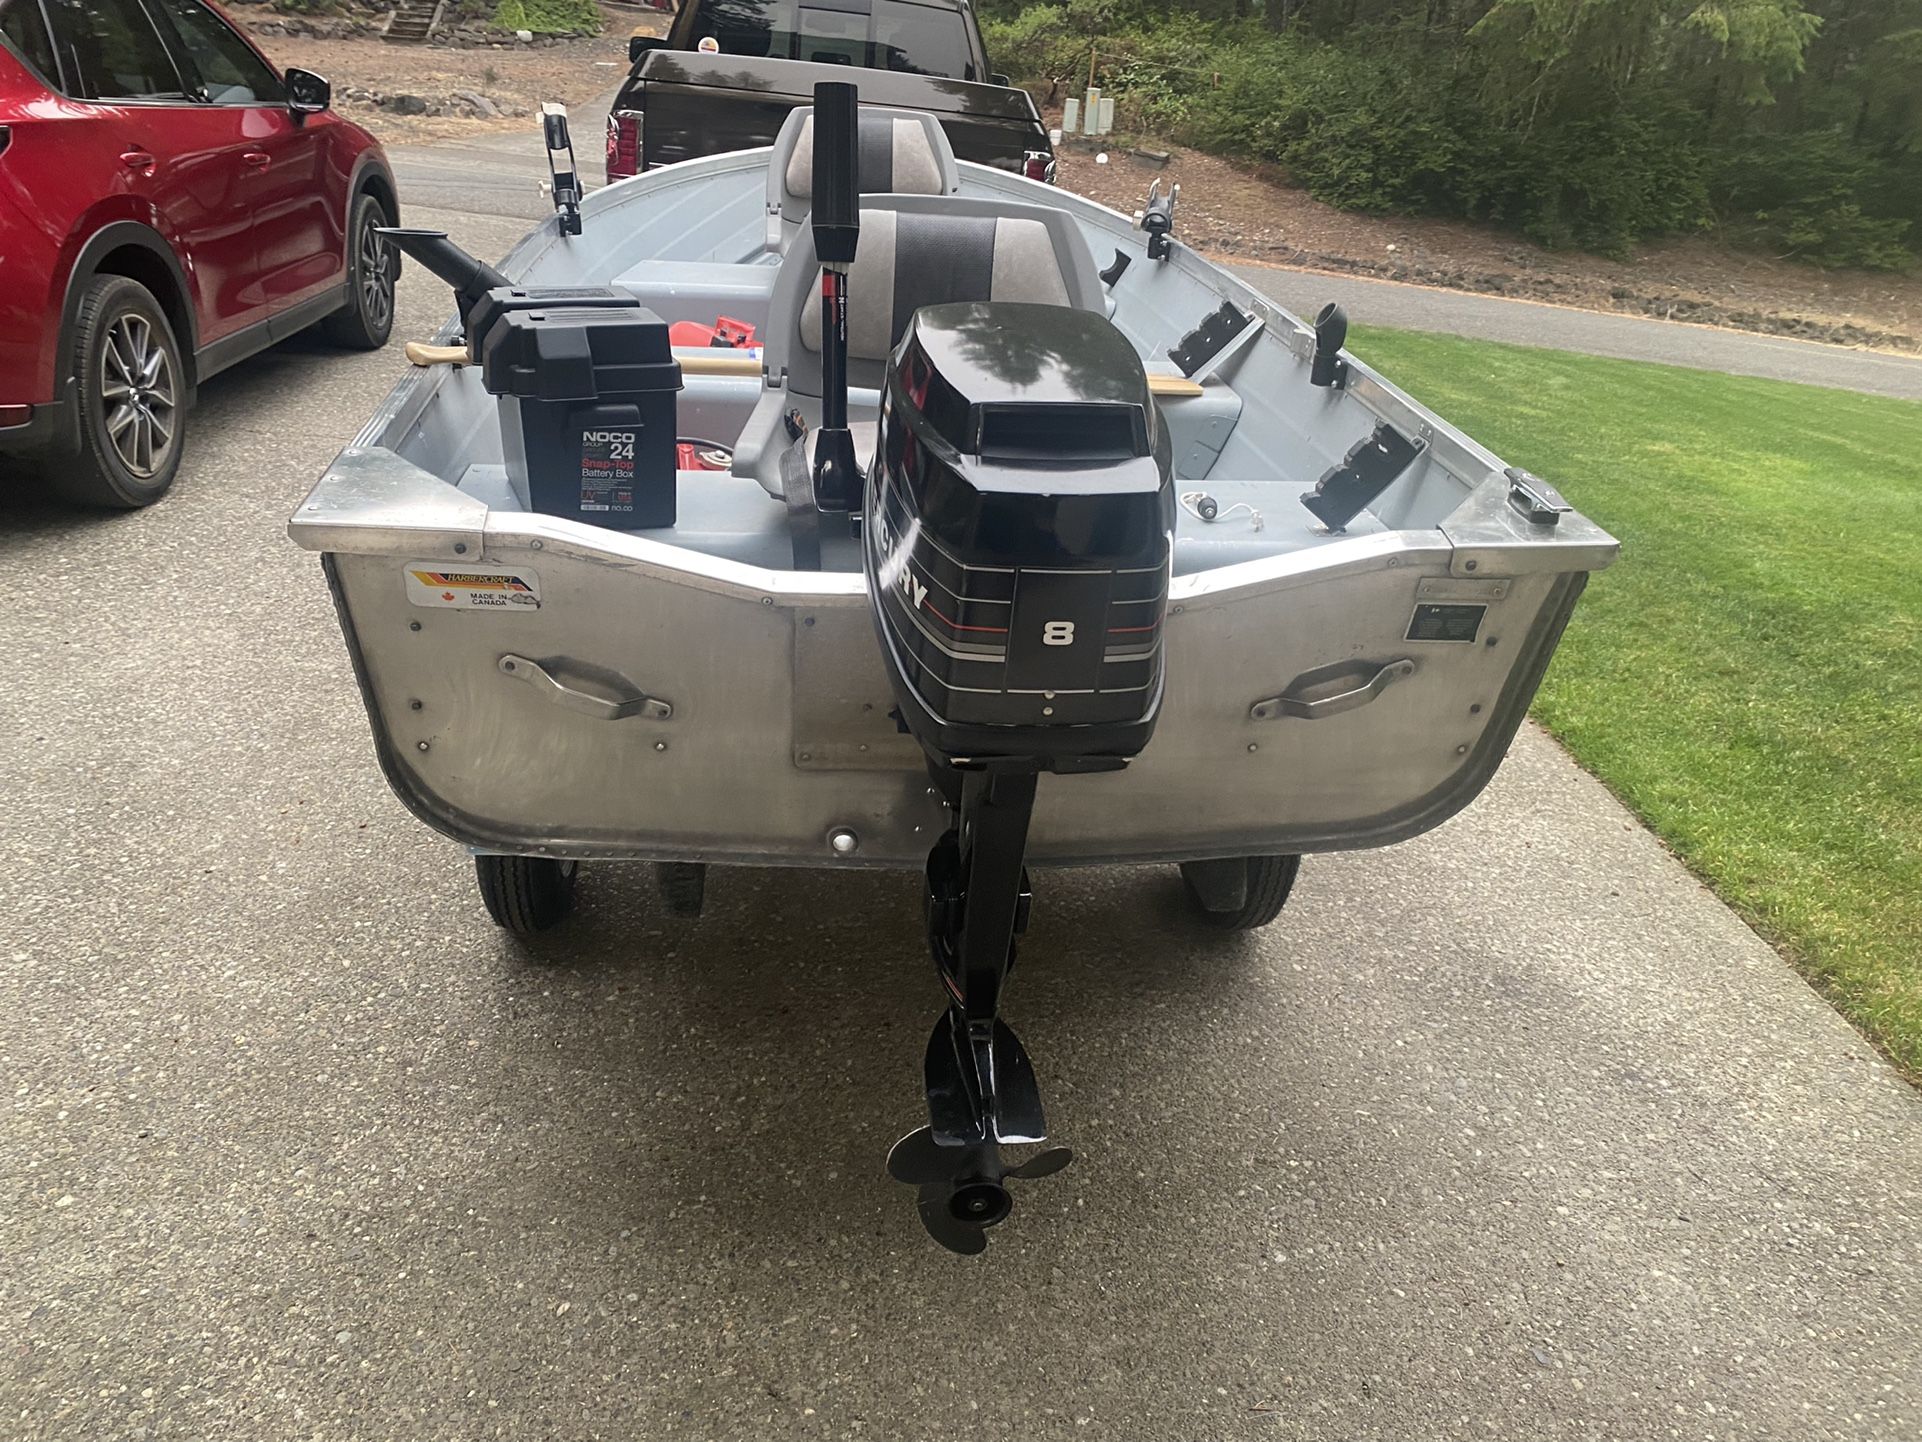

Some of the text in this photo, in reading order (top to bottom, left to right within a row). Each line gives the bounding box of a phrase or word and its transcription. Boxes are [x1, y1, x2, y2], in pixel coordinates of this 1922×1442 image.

[583, 431, 636, 443] NOCO
[609, 443, 635, 460] 24
[582, 458, 634, 469] Snap-Top
[582, 468, 634, 479] Battery Box
[447, 574, 513, 584] HARBERCRAFT
[1042, 621, 1075, 646] 8
